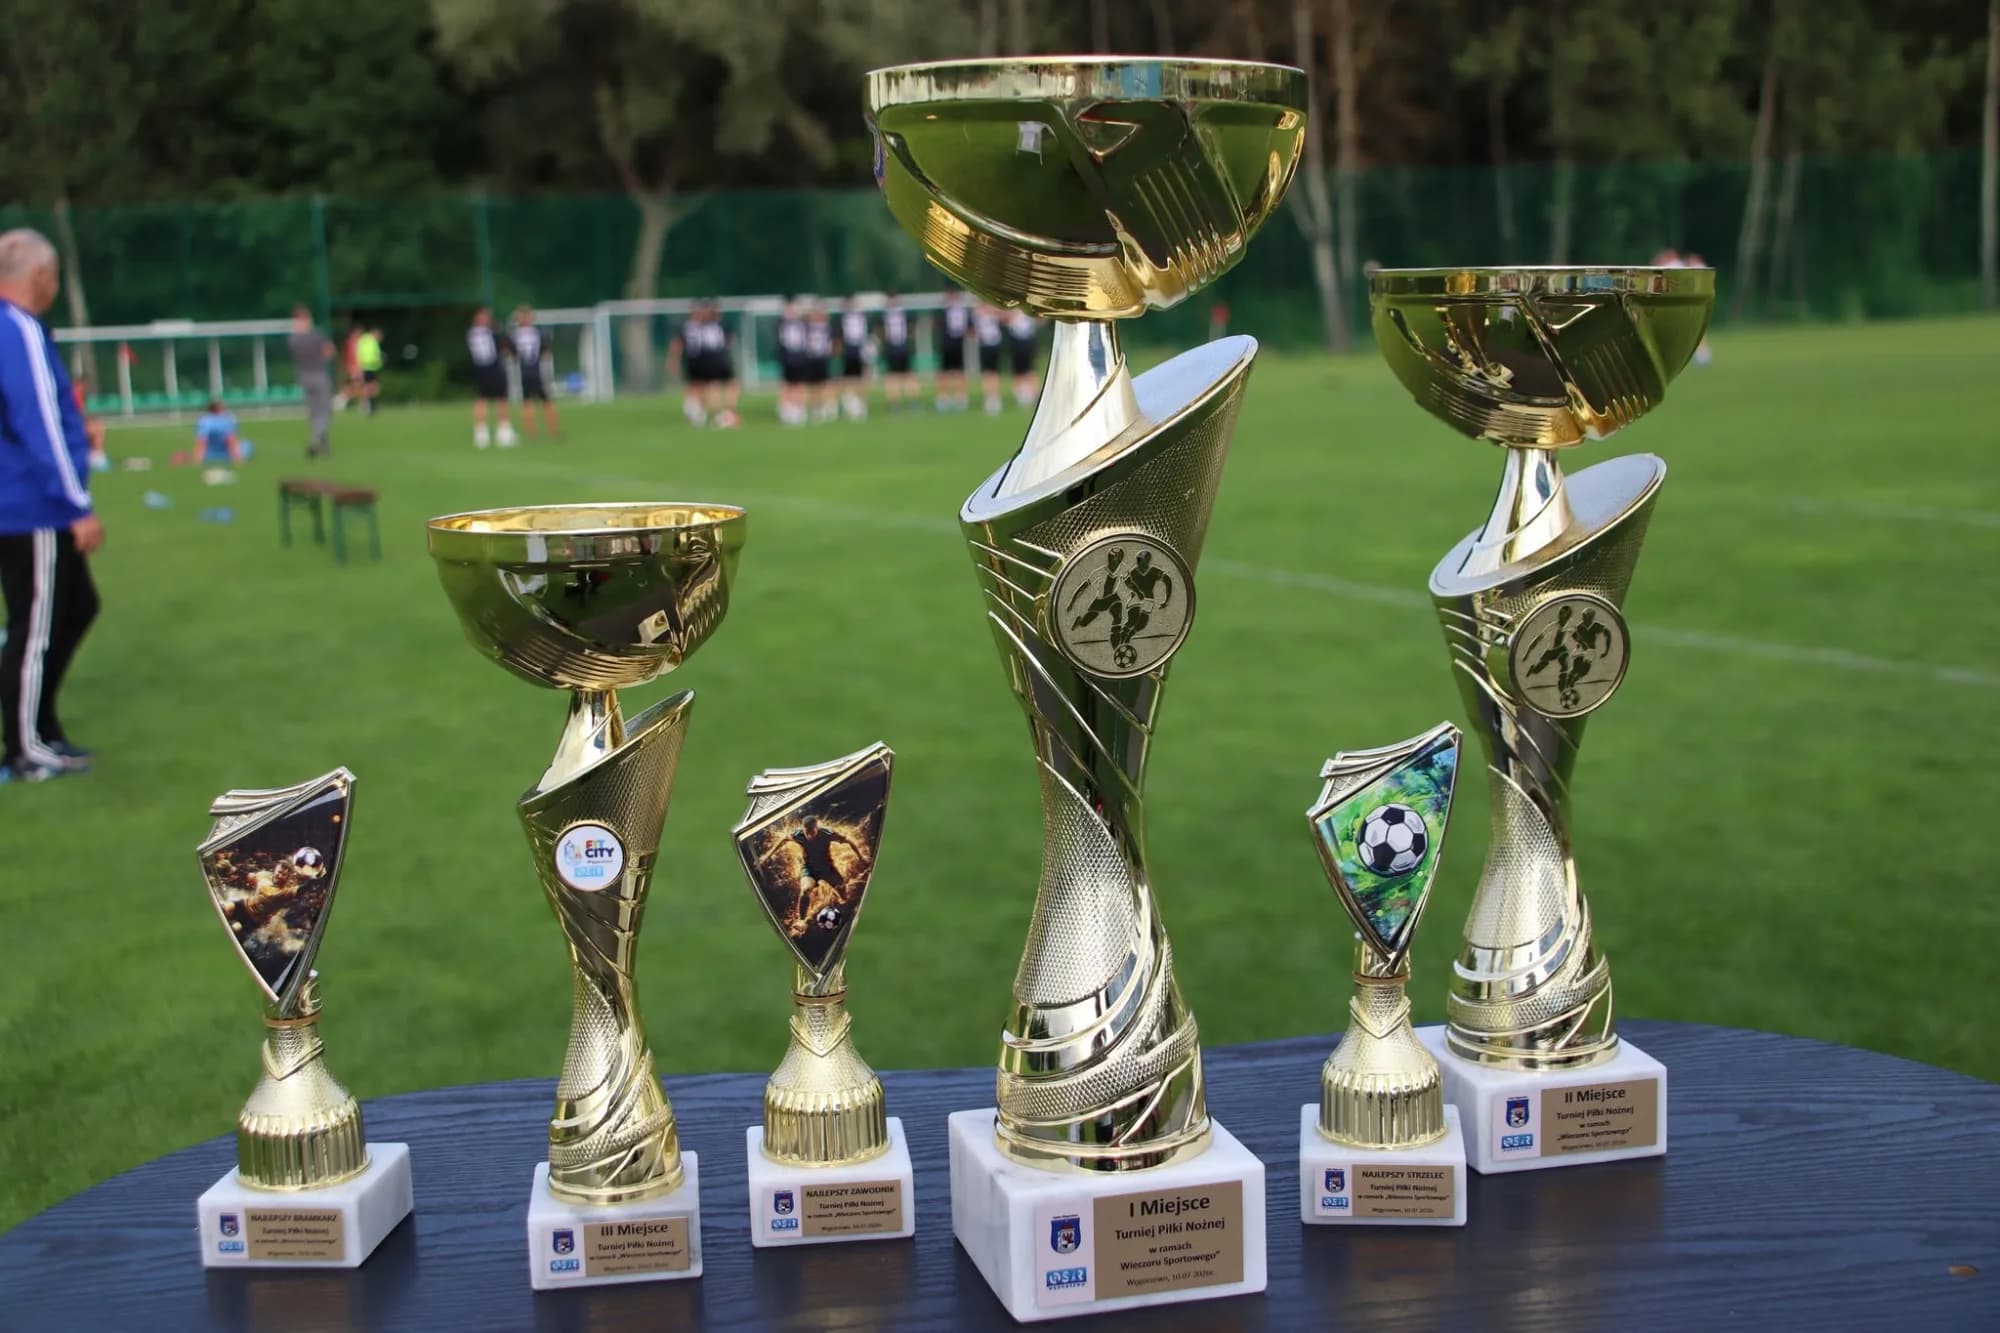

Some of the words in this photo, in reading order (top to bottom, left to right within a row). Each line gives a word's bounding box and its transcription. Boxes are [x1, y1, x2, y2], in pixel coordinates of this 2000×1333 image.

[585, 848, 614, 858] CITY
[1564, 1092, 1573, 1103] II
[1577, 1088, 1626, 1103] Miejsce
[1556, 1110, 1585, 1121] Turniej
[1361, 1171, 1405, 1179] NAJLEPSZY
[1407, 1171, 1445, 1179] STRZELEC
[806, 1188, 848, 1198] NAJLEPSZY
[850, 1185, 896, 1196] ZAWODNIK
[1130, 1202, 1135, 1218] I
[1141, 1197, 1210, 1216] Miejsce
[601, 1226, 613, 1236] III
[617, 1223, 669, 1237] Miejsce
[1115, 1225, 1155, 1240] Turniej
[1158, 1222, 1183, 1235] Piłki
[1185, 1217, 1225, 1233] Nożnej
[598, 1243, 626, 1252] Turniej
[1159, 1241, 1192, 1253] ramach
